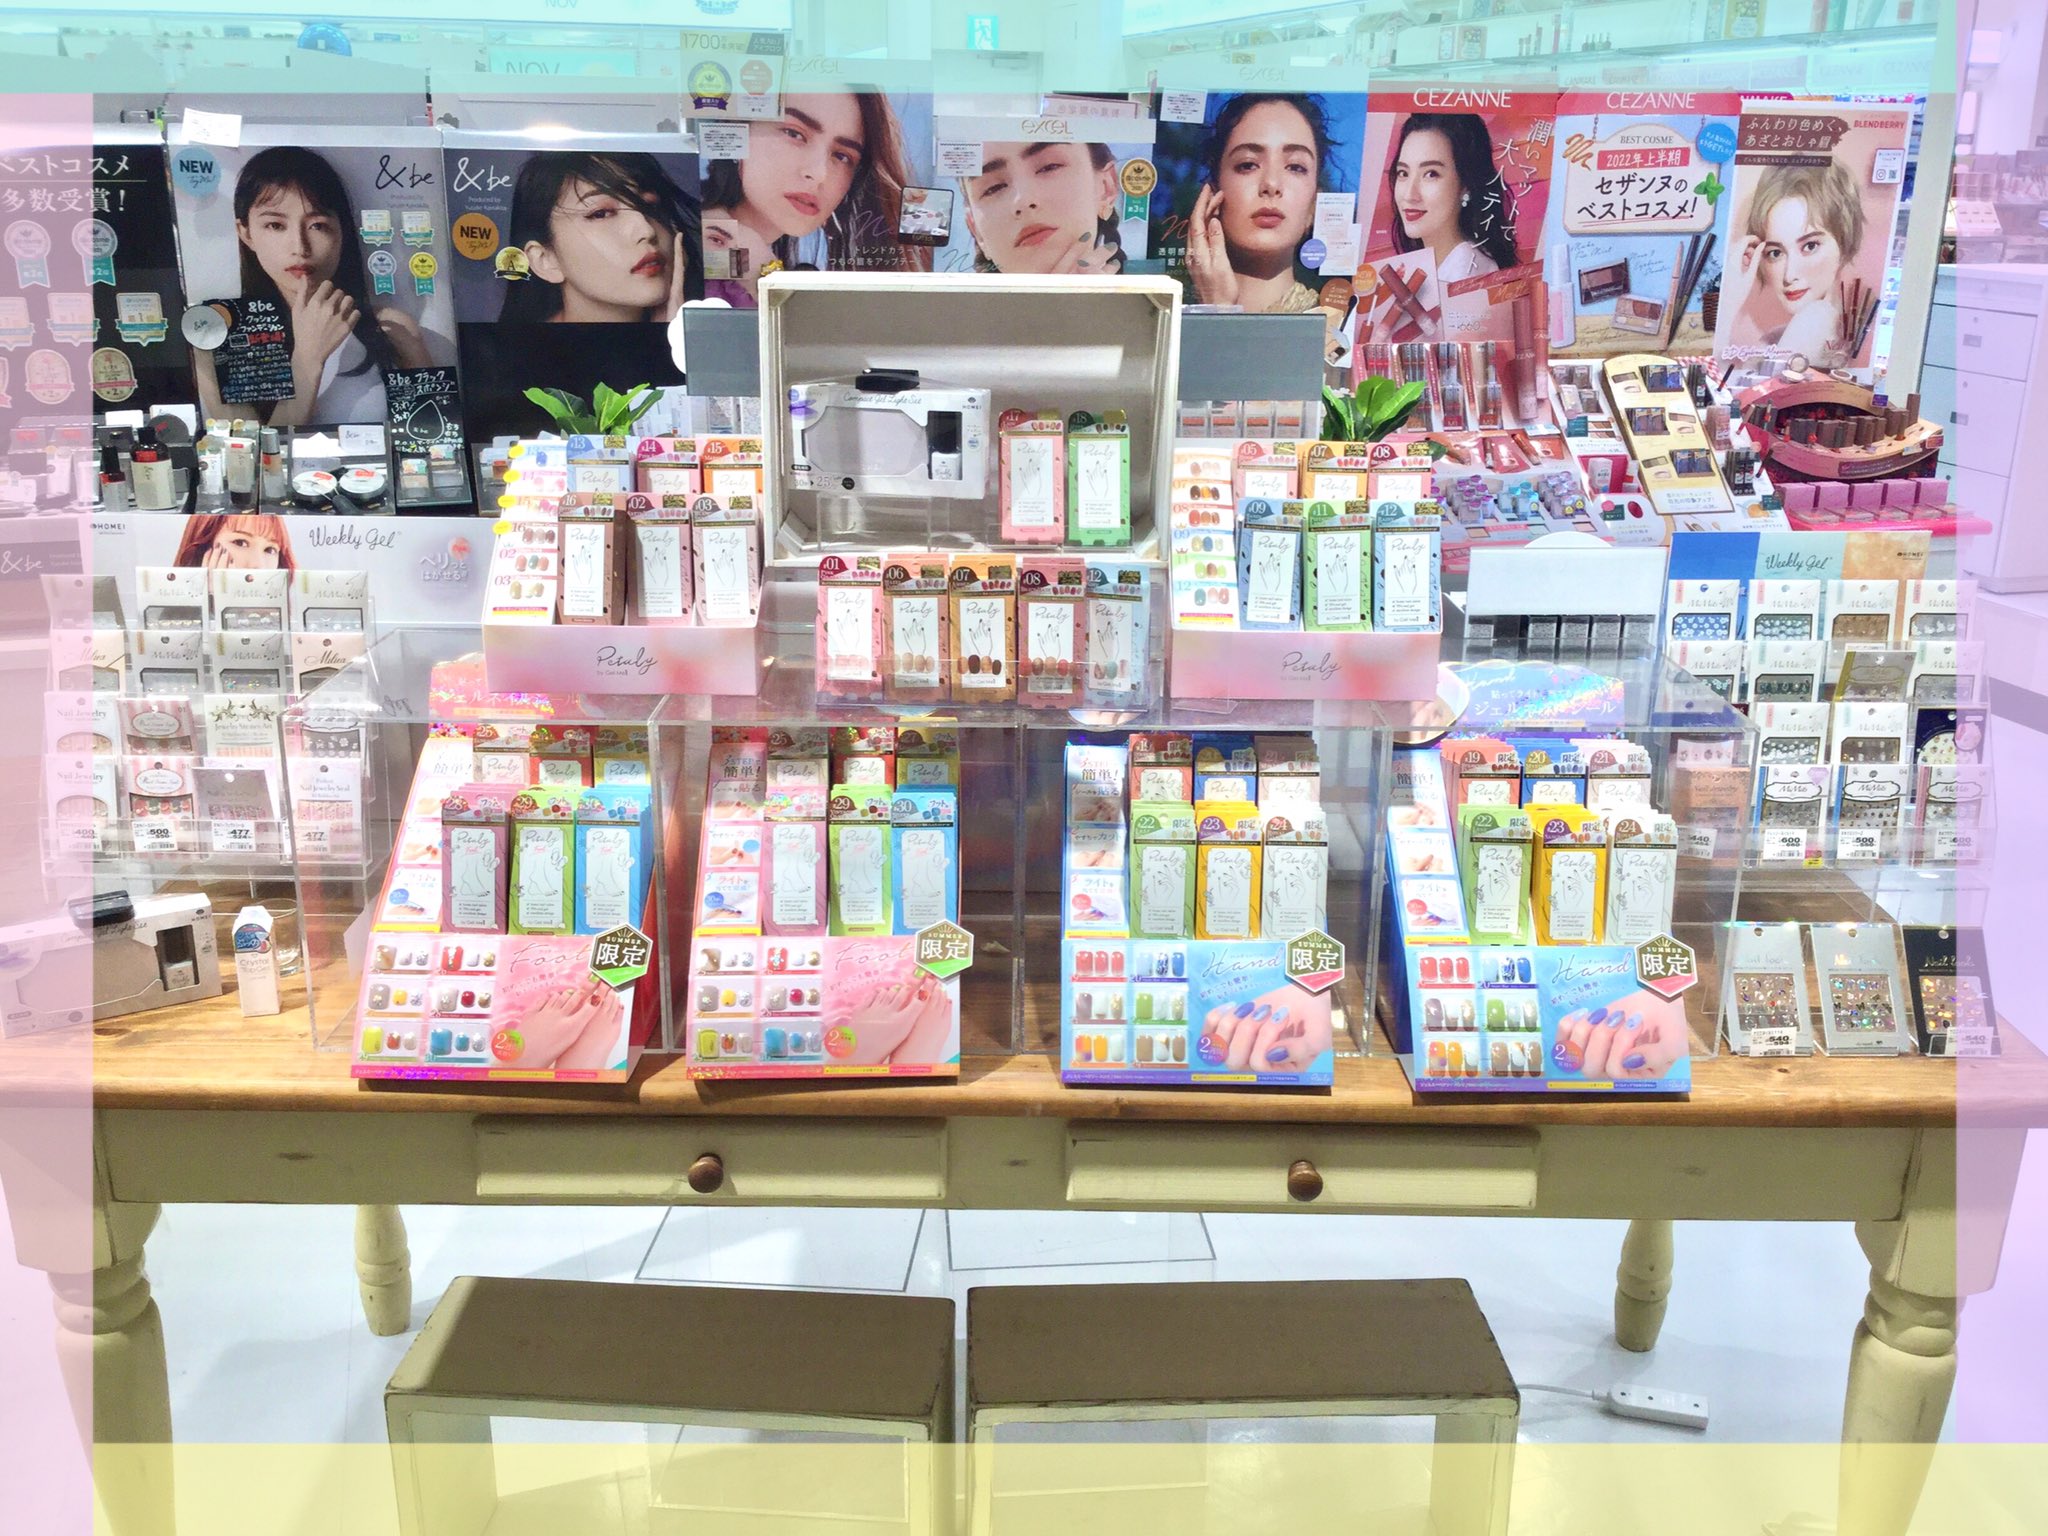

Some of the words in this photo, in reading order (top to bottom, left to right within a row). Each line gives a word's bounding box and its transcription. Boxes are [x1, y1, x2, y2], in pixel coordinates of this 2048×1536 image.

[1413, 87, 1512, 108] CEZANNE
[1606, 92, 1696, 109] CEZANNE
[1746, 117, 1844, 132] ふんわり色めく、
[1853, 119, 1905, 130] BLENDBERRY
[1620, 135, 1645, 145] BEST
[1647, 135, 1675, 145] COSME
[1606, 149, 1682, 168] 2022年上半期
[179, 159, 214, 174] NEW
[374, 154, 435, 190] &be
[453, 156, 513, 193] &be
[1594, 172, 1688, 196] セザンヌの
[1576, 197, 1698, 220] ベストコスメ!
[460, 225, 492, 240] NEW
[247, 300, 275, 313] &be
[245, 315, 279, 323] クッション
[387, 373, 412, 386] &be
[1172, 503, 1190, 515] 08
[309, 524, 362, 548] Weekly
[365, 528, 396, 550] Gel
[1173, 528, 1191, 541] 09
[499, 549, 517, 560] 02
[418, 553, 467, 570] ペリっと
[1765, 552, 1804, 570] Weekly
[1805, 555, 1829, 571] Gel
[494, 575, 512, 587] 03
[1497, 753, 1515, 764] 限定
[1562, 753, 1582, 764] 限定
[723, 766, 762, 779] 簡単!
[1081, 768, 1119, 781] 簡単!
[1509, 817, 1528, 828] 限定
[1692, 835, 1710, 843] 440
[1781, 836, 1801, 844] 600
[1855, 836, 1875, 844] 500
[605, 935, 642, 945] SUMMER
[927, 932, 963, 940] SUMMER
[920, 938, 969, 960] 限定
[1297, 941, 1333, 949] SUMMER
[1646, 946, 1683, 954] SUMMER
[595, 942, 646, 968] 限定
[1291, 948, 1340, 972] 限定
[1641, 953, 1693, 978] 限定
[1769, 1035, 1790, 1043] 540
